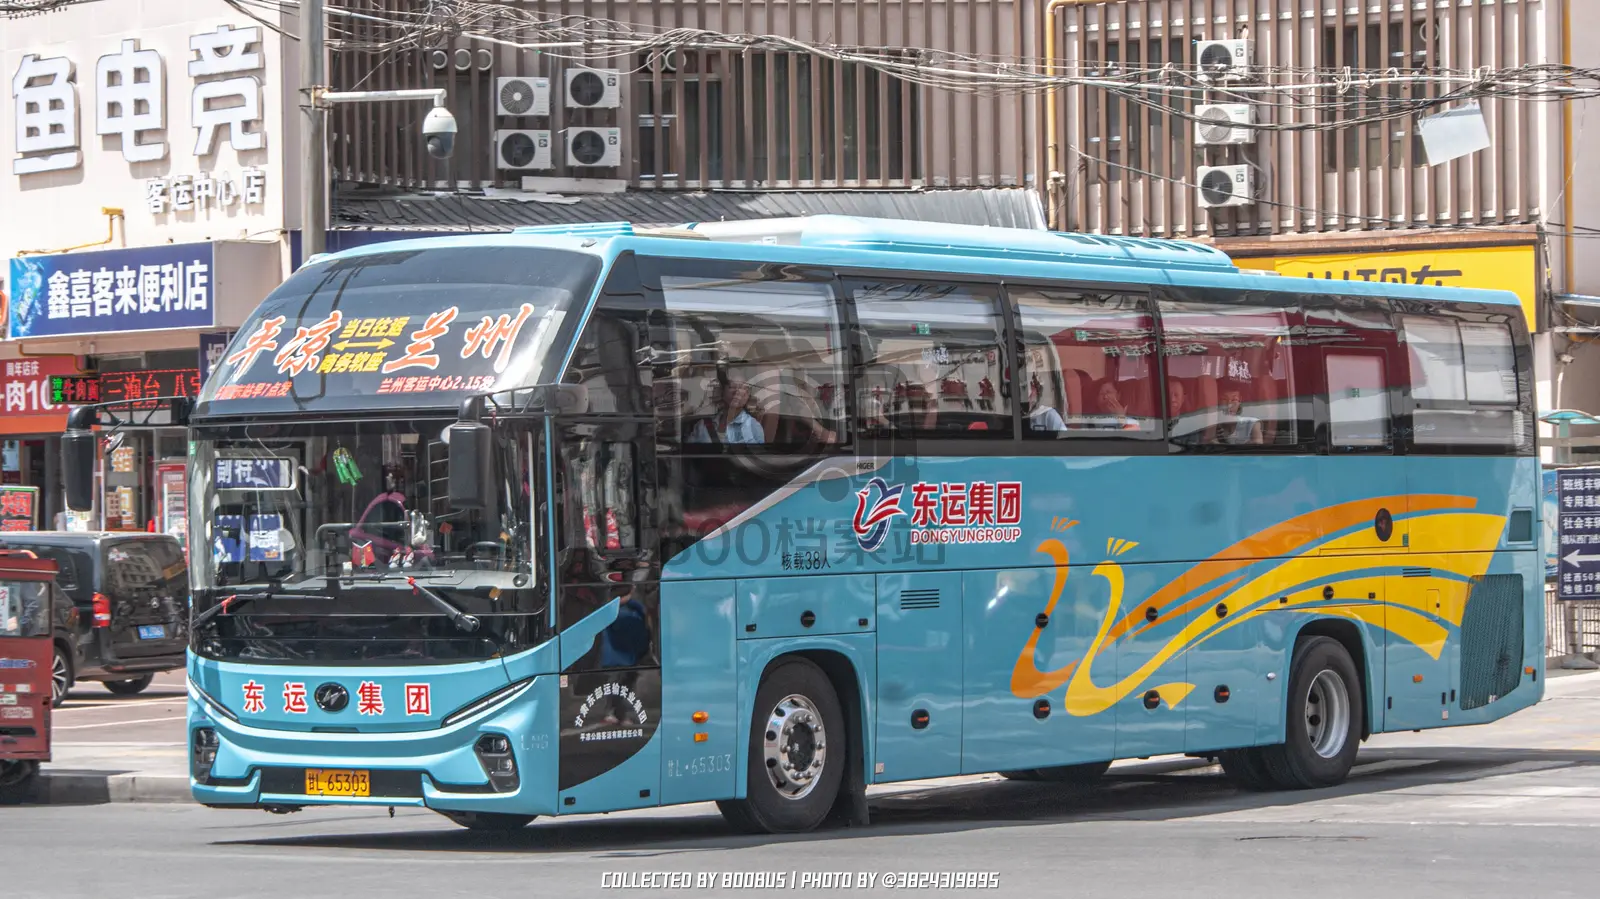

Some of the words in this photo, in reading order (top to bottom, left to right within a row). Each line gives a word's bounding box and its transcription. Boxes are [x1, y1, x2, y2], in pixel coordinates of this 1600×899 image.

[12, 24, 265, 175] 鱼电竞
[147, 166, 266, 214] 客运中心店
[47, 260, 208, 319] 鑫喜客来便利店
[227, 310, 342, 379] 平凉
[338, 316, 411, 338] 当日往返
[381, 302, 535, 374] 兰州
[320, 351, 388, 373] 商务软座
[856, 462, 875, 470] HIGER
[910, 480, 1023, 528] 东运集团
[910, 526, 1022, 544] DONGYUNGROUP
[781, 550, 832, 571] 核载38人
[242, 679, 432, 716] 东运集团
